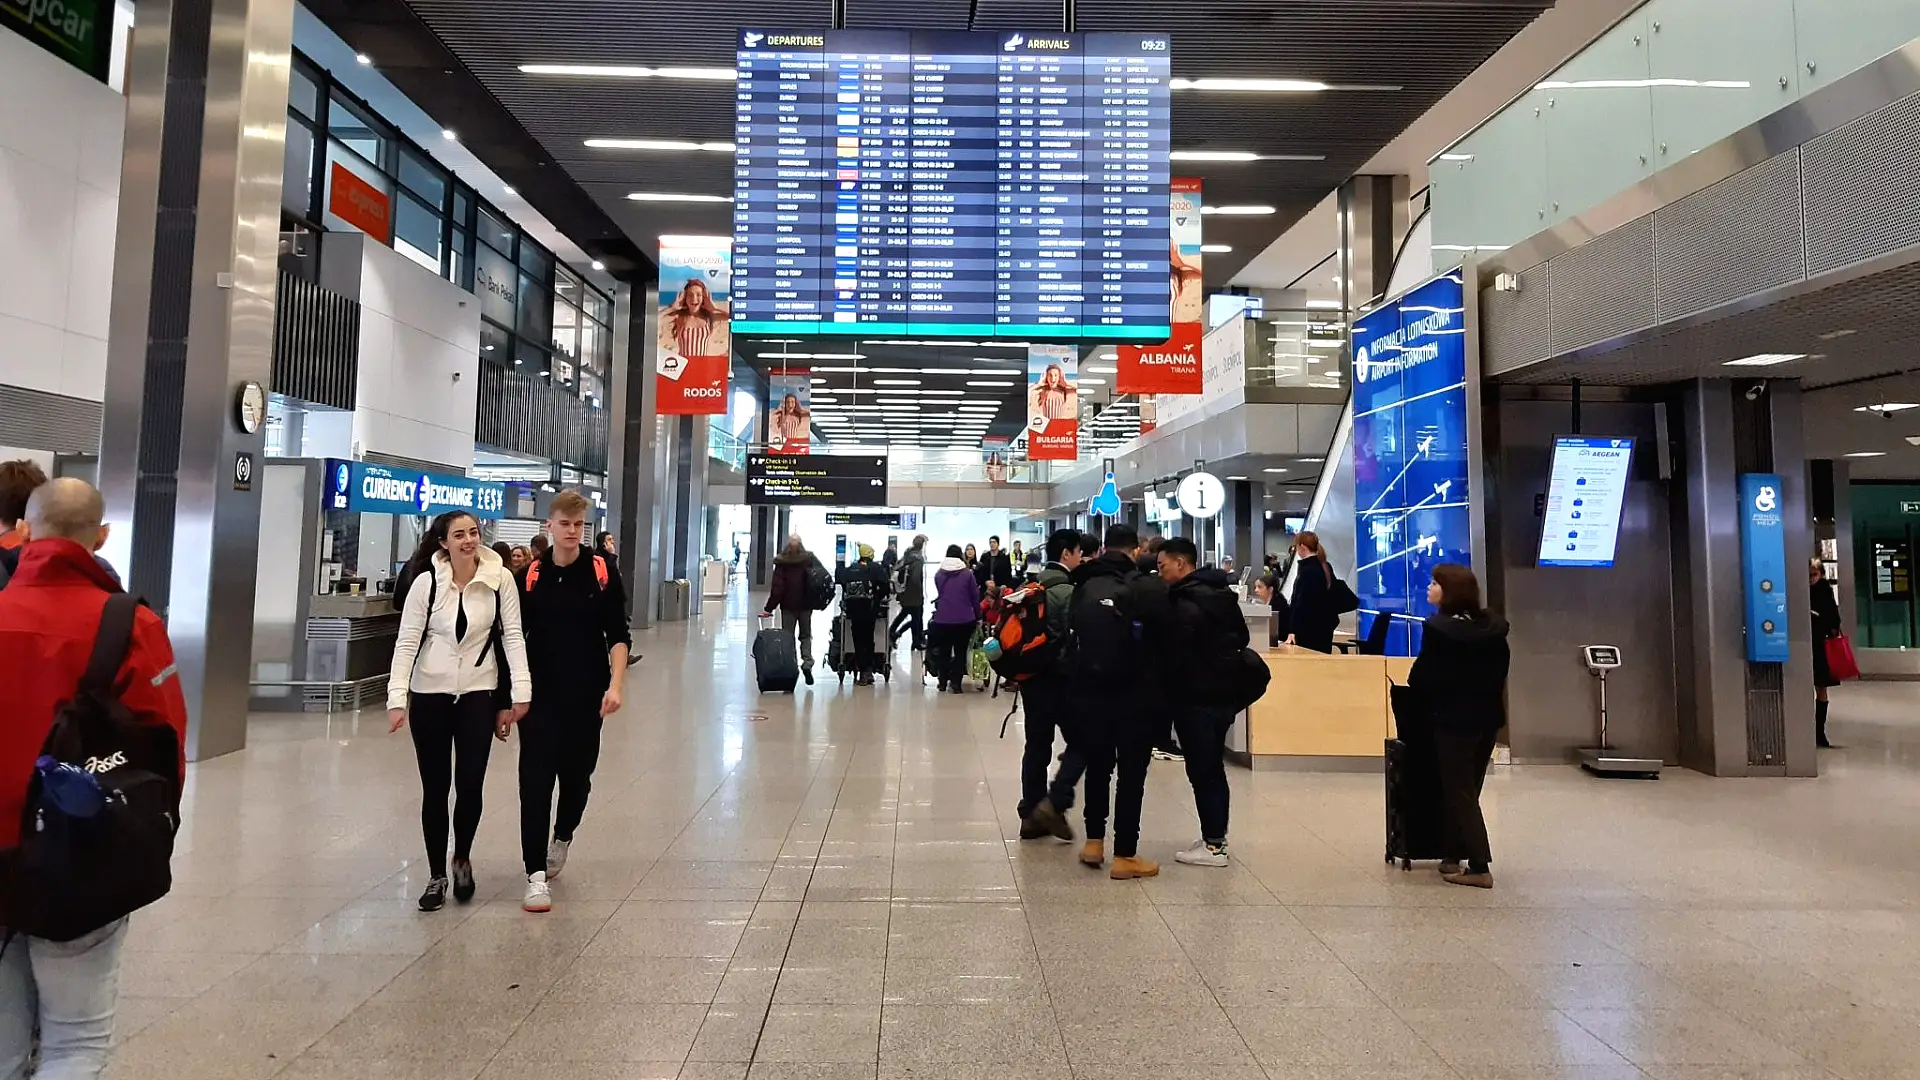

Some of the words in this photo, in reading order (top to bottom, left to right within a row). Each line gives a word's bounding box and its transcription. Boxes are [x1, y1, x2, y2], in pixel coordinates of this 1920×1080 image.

[767, 36, 824, 46] DEPARTURES
[1027, 40, 1070, 49] ARRIVALS
[1142, 40, 1166, 50] 09:23
[1370, 327, 1406, 357] INFORMACJA
[1407, 308, 1450, 342] LOTNISKOWA
[1140, 353, 1196, 364] ALBANIA
[1372, 358, 1394, 382] AIRPORT
[1395, 340, 1438, 372] INFORMATION
[684, 387, 722, 398] RODOS
[362, 476, 416, 502] CURRENCY
[430, 484, 474, 507] EXCHANGE
[334, 492, 347, 508] ice
